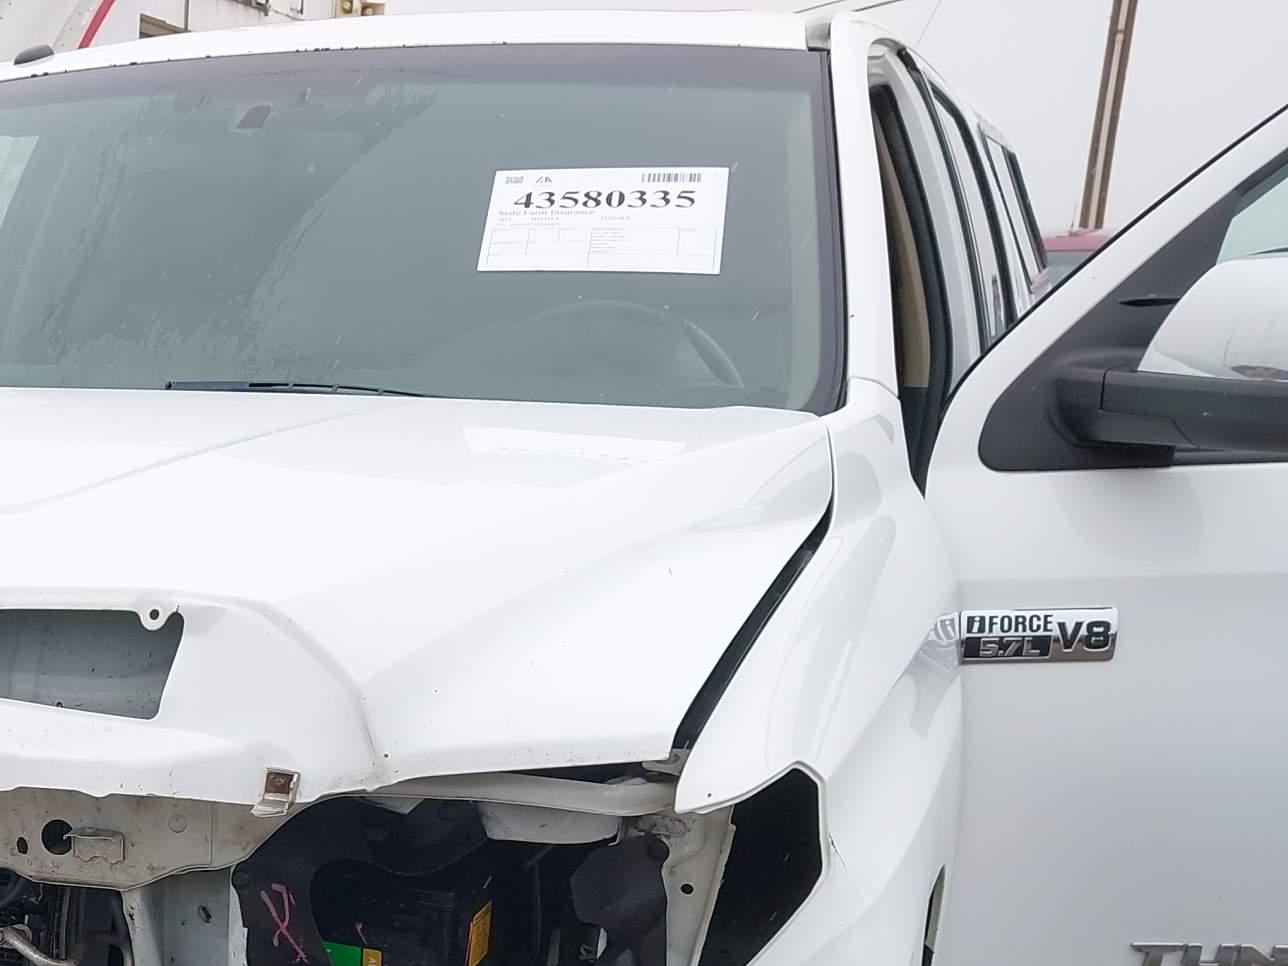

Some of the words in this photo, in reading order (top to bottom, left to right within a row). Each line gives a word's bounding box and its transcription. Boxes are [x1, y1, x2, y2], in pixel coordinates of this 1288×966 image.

[513, 190, 696, 209] 43580335
[1057, 620, 1112, 653] V8
[978, 637, 1041, 657] 5.7L
